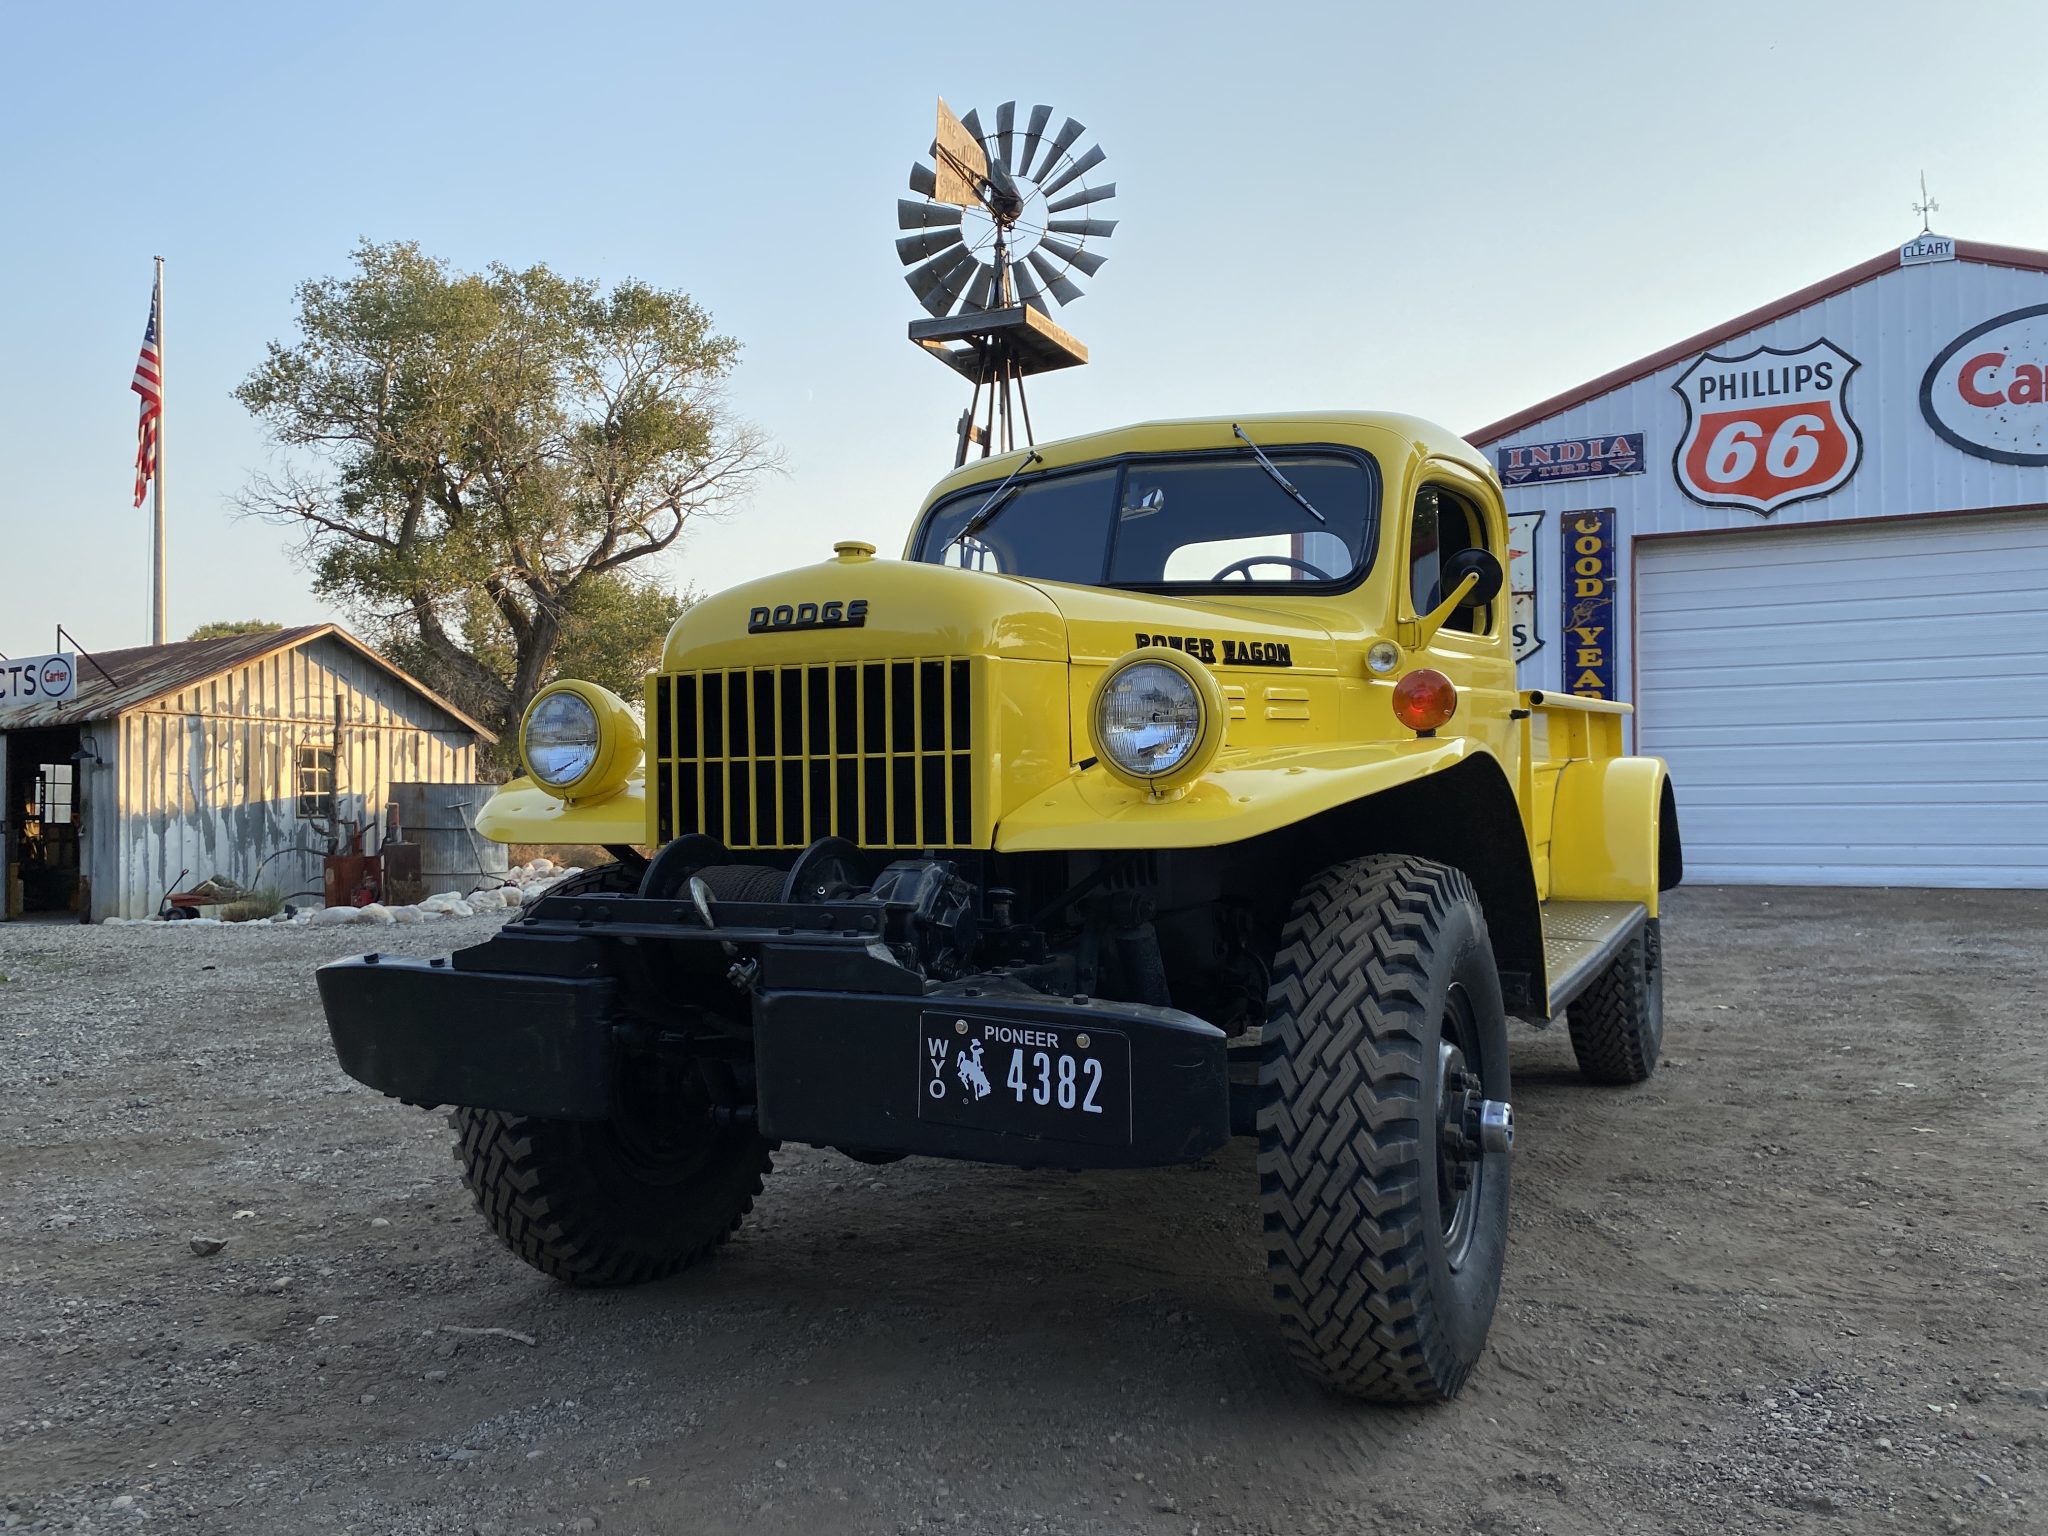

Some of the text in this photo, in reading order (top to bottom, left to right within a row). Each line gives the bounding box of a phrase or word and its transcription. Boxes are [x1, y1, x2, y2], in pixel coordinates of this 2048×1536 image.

[1903, 241, 1950, 258] CLEARY
[1700, 361, 1833, 403] PHILLIPS
[1507, 436, 1636, 468] INDIA
[1705, 414, 1826, 484] 66
[1538, 461, 1603, 477] TIRES
[747, 599, 868, 630] DODGE
[1135, 633, 1292, 666] POWER WAGON
[44, 669, 67, 683] Carter
[984, 1025, 1059, 1048] PIONEER
[928, 1037, 949, 1099] WYO
[1007, 1048, 1103, 1114] 4382
